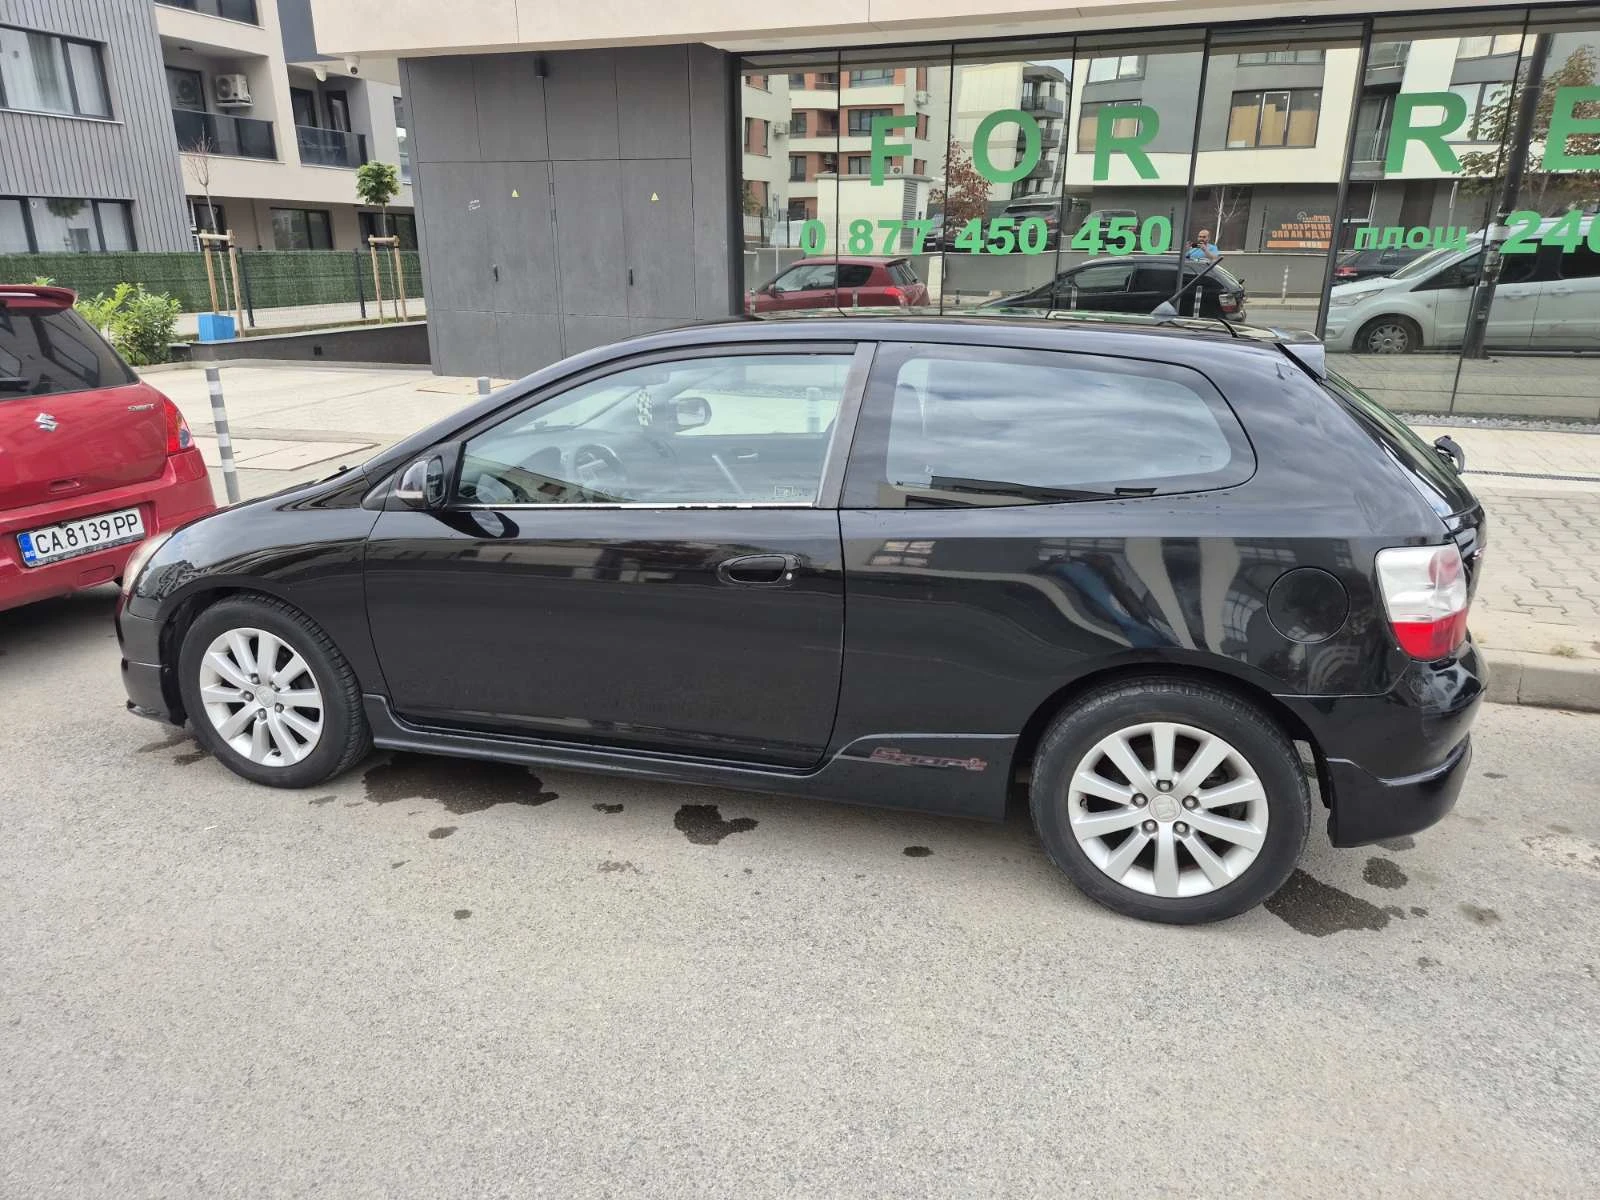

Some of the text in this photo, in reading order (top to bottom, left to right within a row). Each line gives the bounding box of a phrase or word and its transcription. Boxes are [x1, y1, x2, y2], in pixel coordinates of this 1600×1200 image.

[870, 107, 1160, 187] FOR
[800, 216, 1173, 257] 0 877 450 450
[1354, 226, 1469, 254] площ
